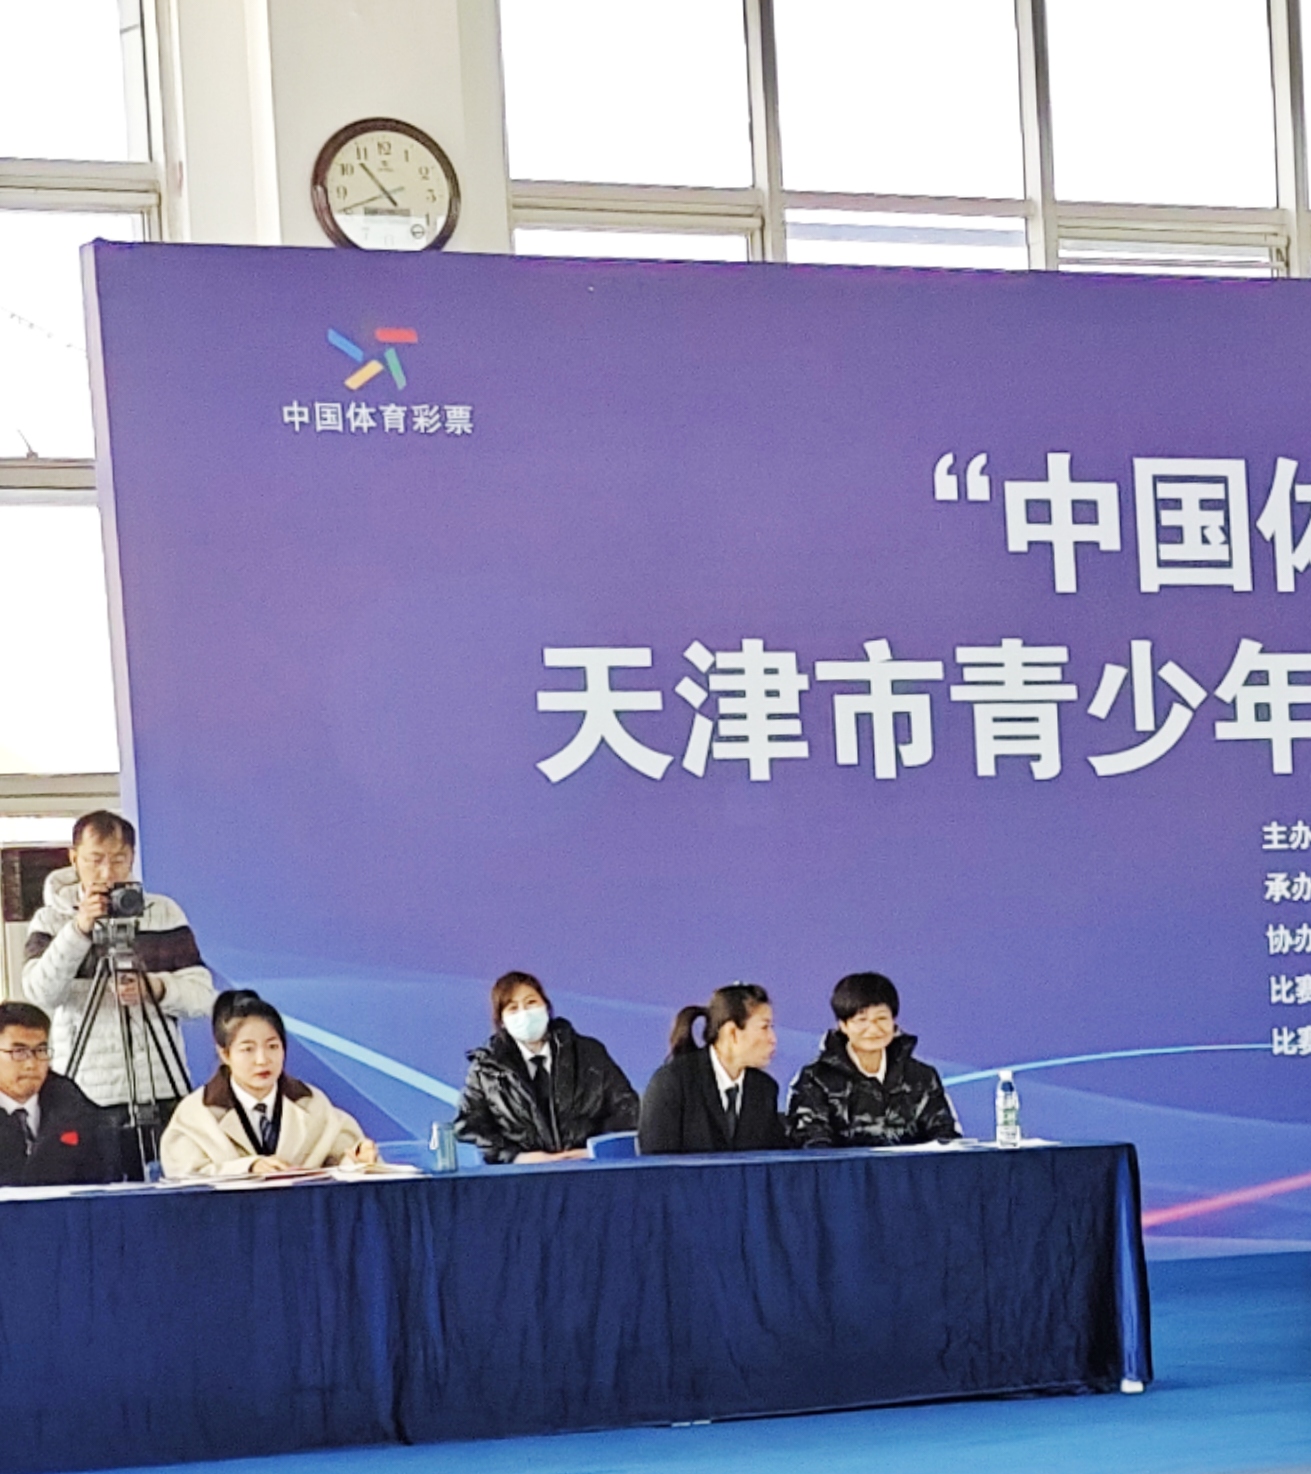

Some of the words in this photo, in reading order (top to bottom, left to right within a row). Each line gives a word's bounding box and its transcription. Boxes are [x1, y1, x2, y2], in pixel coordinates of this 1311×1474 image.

[282, 400, 475, 434] 中国体育彩票
